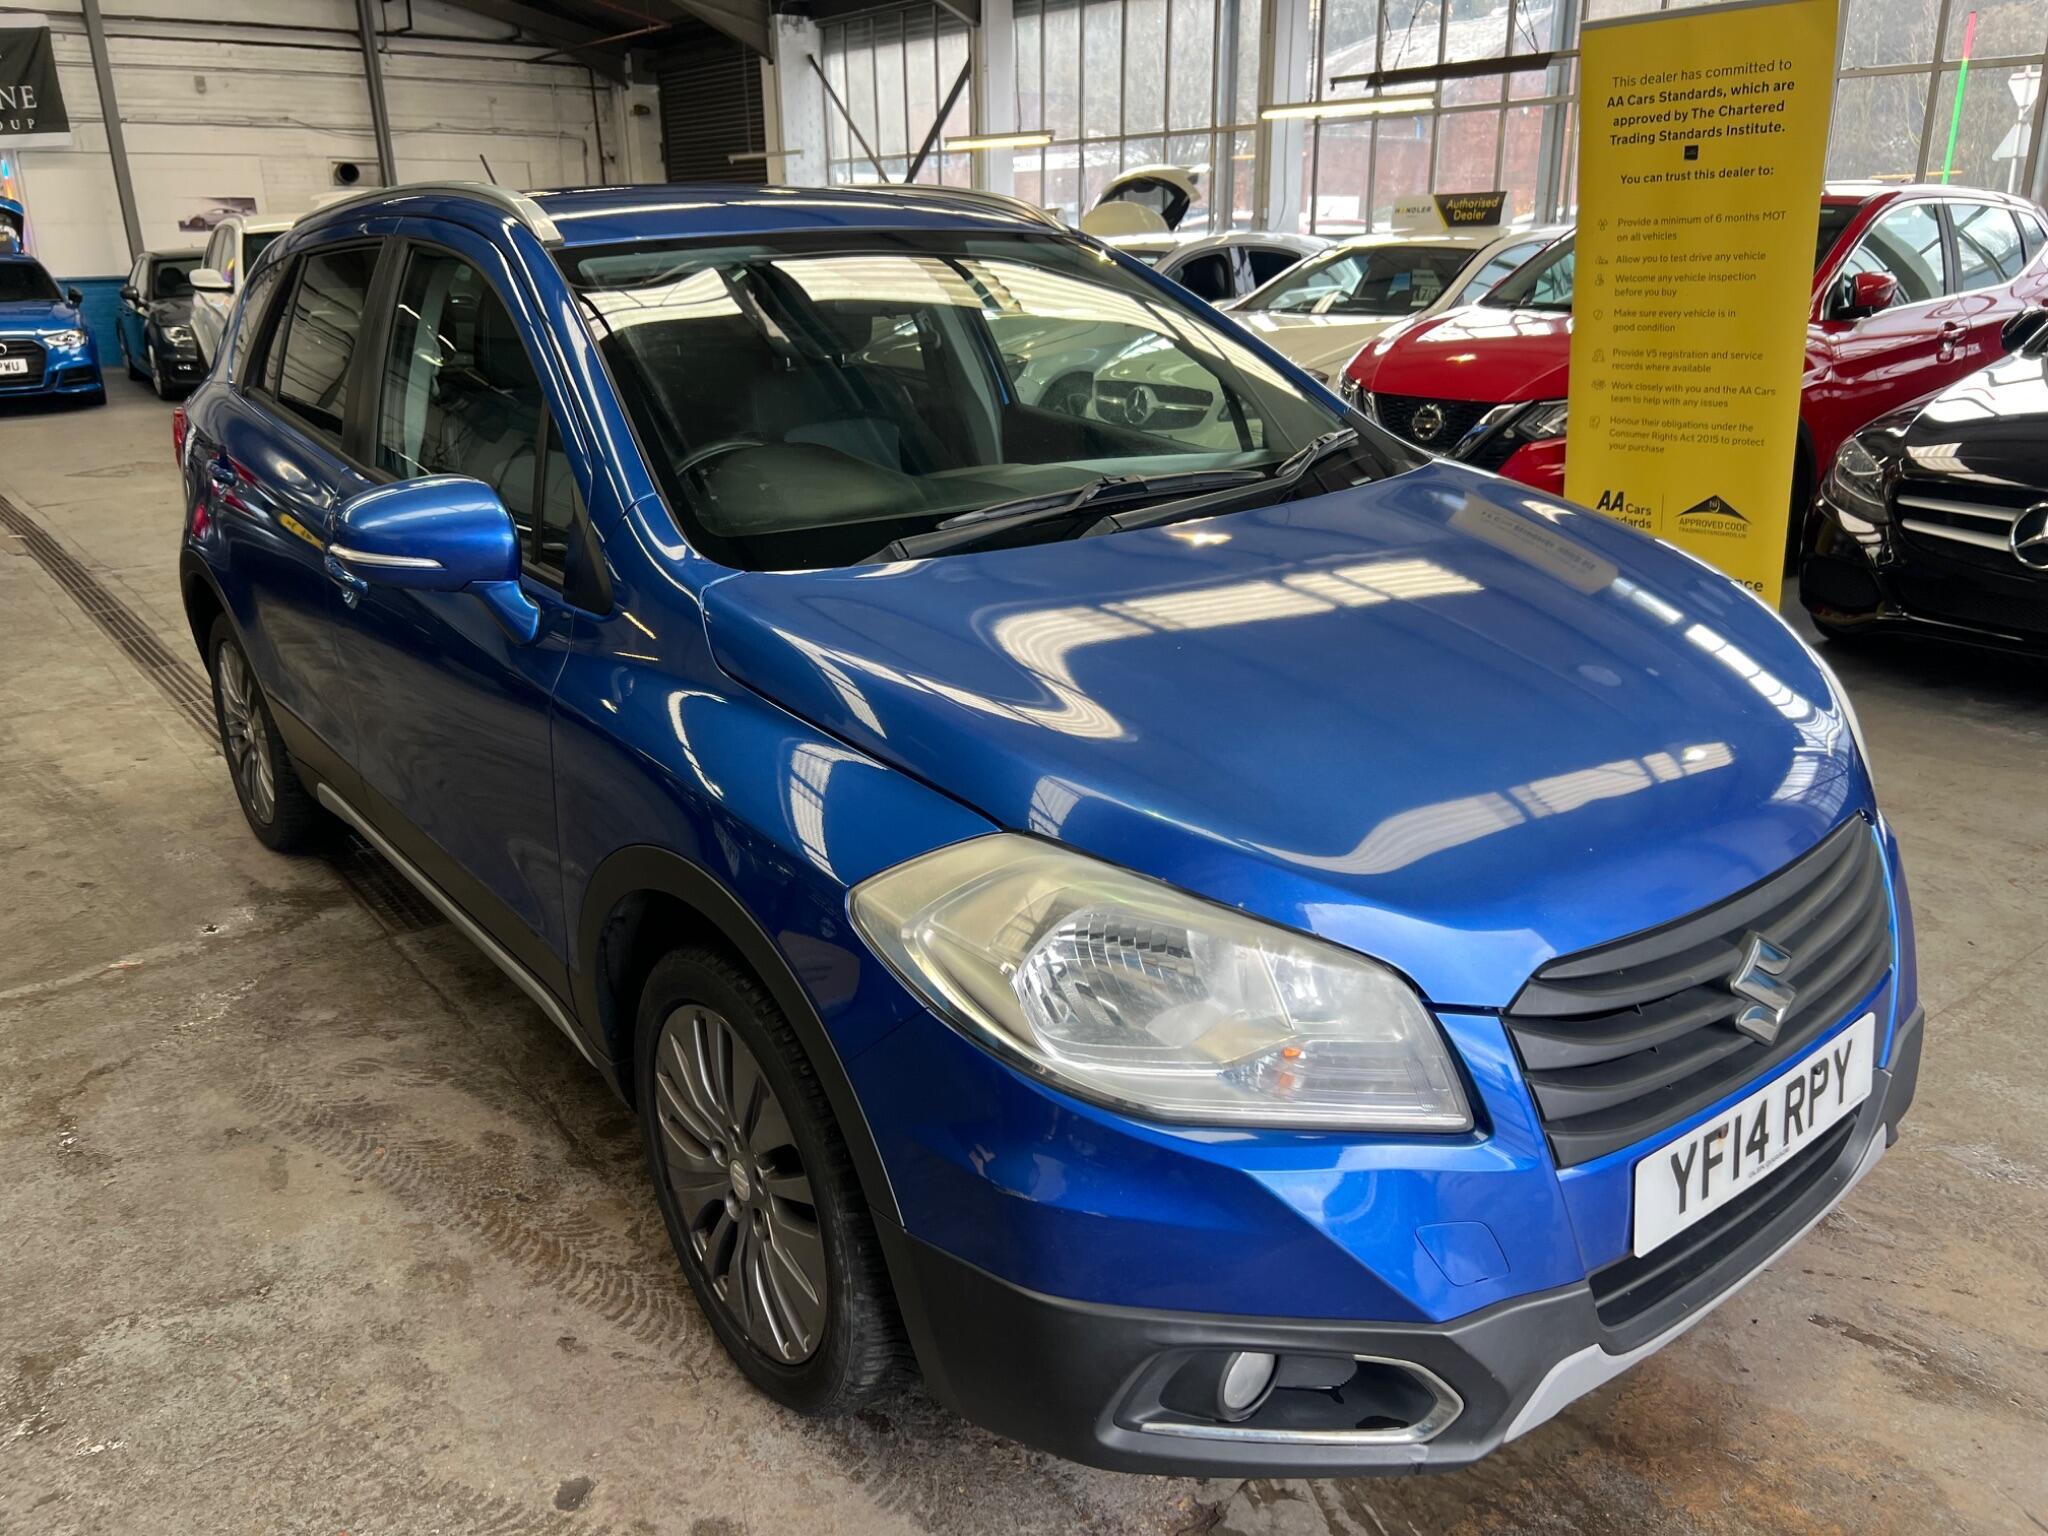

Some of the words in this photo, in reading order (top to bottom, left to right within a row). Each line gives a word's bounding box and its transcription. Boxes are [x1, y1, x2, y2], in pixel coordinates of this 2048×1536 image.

[1612, 75, 1636, 88] This
[1640, 72, 1677, 85] dealer
[1681, 69, 1702, 81] has
[1705, 60, 1775, 78] committed
[1780, 60, 1792, 71] to
[1607, 96, 1624, 107] AA
[1628, 93, 1655, 106] Cars
[1659, 87, 1727, 103] Standards,
[1731, 81, 1769, 96] which
[1773, 81, 1794, 92] are
[1613, 110, 1671, 128] approved
[1674, 106, 1688, 122] by
[1691, 106, 1715, 119] The
[1718, 101, 1784, 117] Chartered
[1610, 131, 1655, 145] Trading
[1659, 126, 1722, 142] Standards
[1727, 121, 1785, 137] Institute.
[1620, 174, 1640, 184] You
[1644, 173, 1663, 183] can
[1666, 171, 1691, 181] trust
[1695, 168, 1715, 180] this
[1718, 167, 1754, 178] dealer
[1758, 166, 1774, 176] to:
[1446, 197, 1499, 209] Authorised
[1453, 210, 1486, 220] Dealer
[1617, 218, 1652, 227] Provide
[1661, 217, 1701, 225] minimum
[1704, 214, 1713, 223] of
[1716, 214, 1722, 223] 6
[1725, 213, 1760, 222] months
[1762, 211, 1786, 220] MOT
[1617, 234, 1628, 242] on
[1630, 233, 1641, 241] all
[1643, 232, 1677, 240] vehicles
[1616, 255, 1640, 264] Allow
[1642, 256, 1658, 264] you
[1670, 254, 1687, 262] test
[1689, 252, 1712, 262] drive
[1715, 253, 1730, 262] any
[1733, 252, 1766, 260] vehicle
[1616, 274, 1655, 283] Welcome
[1658, 275, 1672, 284] any
[1674, 273, 1706, 282] vehicle
[1708, 272, 1756, 282] inspection
[1615, 288, 1642, 296] before
[1644, 289, 1659, 298] you
[1661, 288, 1677, 297] buy
[1614, 309, 1634, 318] Make
[1658, 310, 1681, 319] every
[1683, 309, 1715, 317] vehicle
[1718, 309, 1725, 318] is
[1727, 309, 1736, 317] in
[1613, 324, 1635, 334] good
[1637, 323, 1675, 332] condition
[1613, 349, 1644, 357] Provide
[1646, 350, 1657, 358] V5
[1659, 351, 1708, 360] registration
[1711, 351, 1728, 360] and
[1730, 352, 1763, 360] service
[1612, 362, 1643, 370] records
[1672, 364, 1711, 373] available
[1612, 381, 1633, 390] Work
[1635, 382, 1663, 392] closely
[1665, 384, 1683, 392] with
[1703, 385, 1720, 393] and
[1723, 386, 1737, 394] the
[1739, 386, 1752, 394] AA
[1754, 387, 1776, 396] Cars
[1611, 395, 1631, 403] team
[1643, 395, 1660, 406] help
[1663, 397, 1680, 405] with
[1683, 398, 1699, 407] any
[1701, 398, 1728, 407] issues
[1610, 416, 1640, 426] Honour
[1642, 418, 1660, 427] their
[1661, 419, 1709, 430] obligations
[1711, 420, 1736, 431] under
[1739, 422, 1753, 432] the
[1609, 429, 1650, 439] Consumer
[1652, 430, 1678, 442] Rights
[1680, 433, 1695, 442] Act
[1697, 433, 1718, 443] 2015
[1721, 435, 1729, 444] to
[1732, 436, 1764, 447] protect
[1609, 443, 1625, 451] your
[1628, 444, 1664, 454] purchase
[1596, 490, 1624, 512] AA
[1626, 503, 1651, 516] Cars
[1616, 516, 1651, 528] dards
[1680, 518, 1724, 530] APPROVED
[1724, 523, 1748, 532] CODE
[1671, 1099, 1769, 1215] YF14
[1783, 1039, 1852, 1146] RPY
